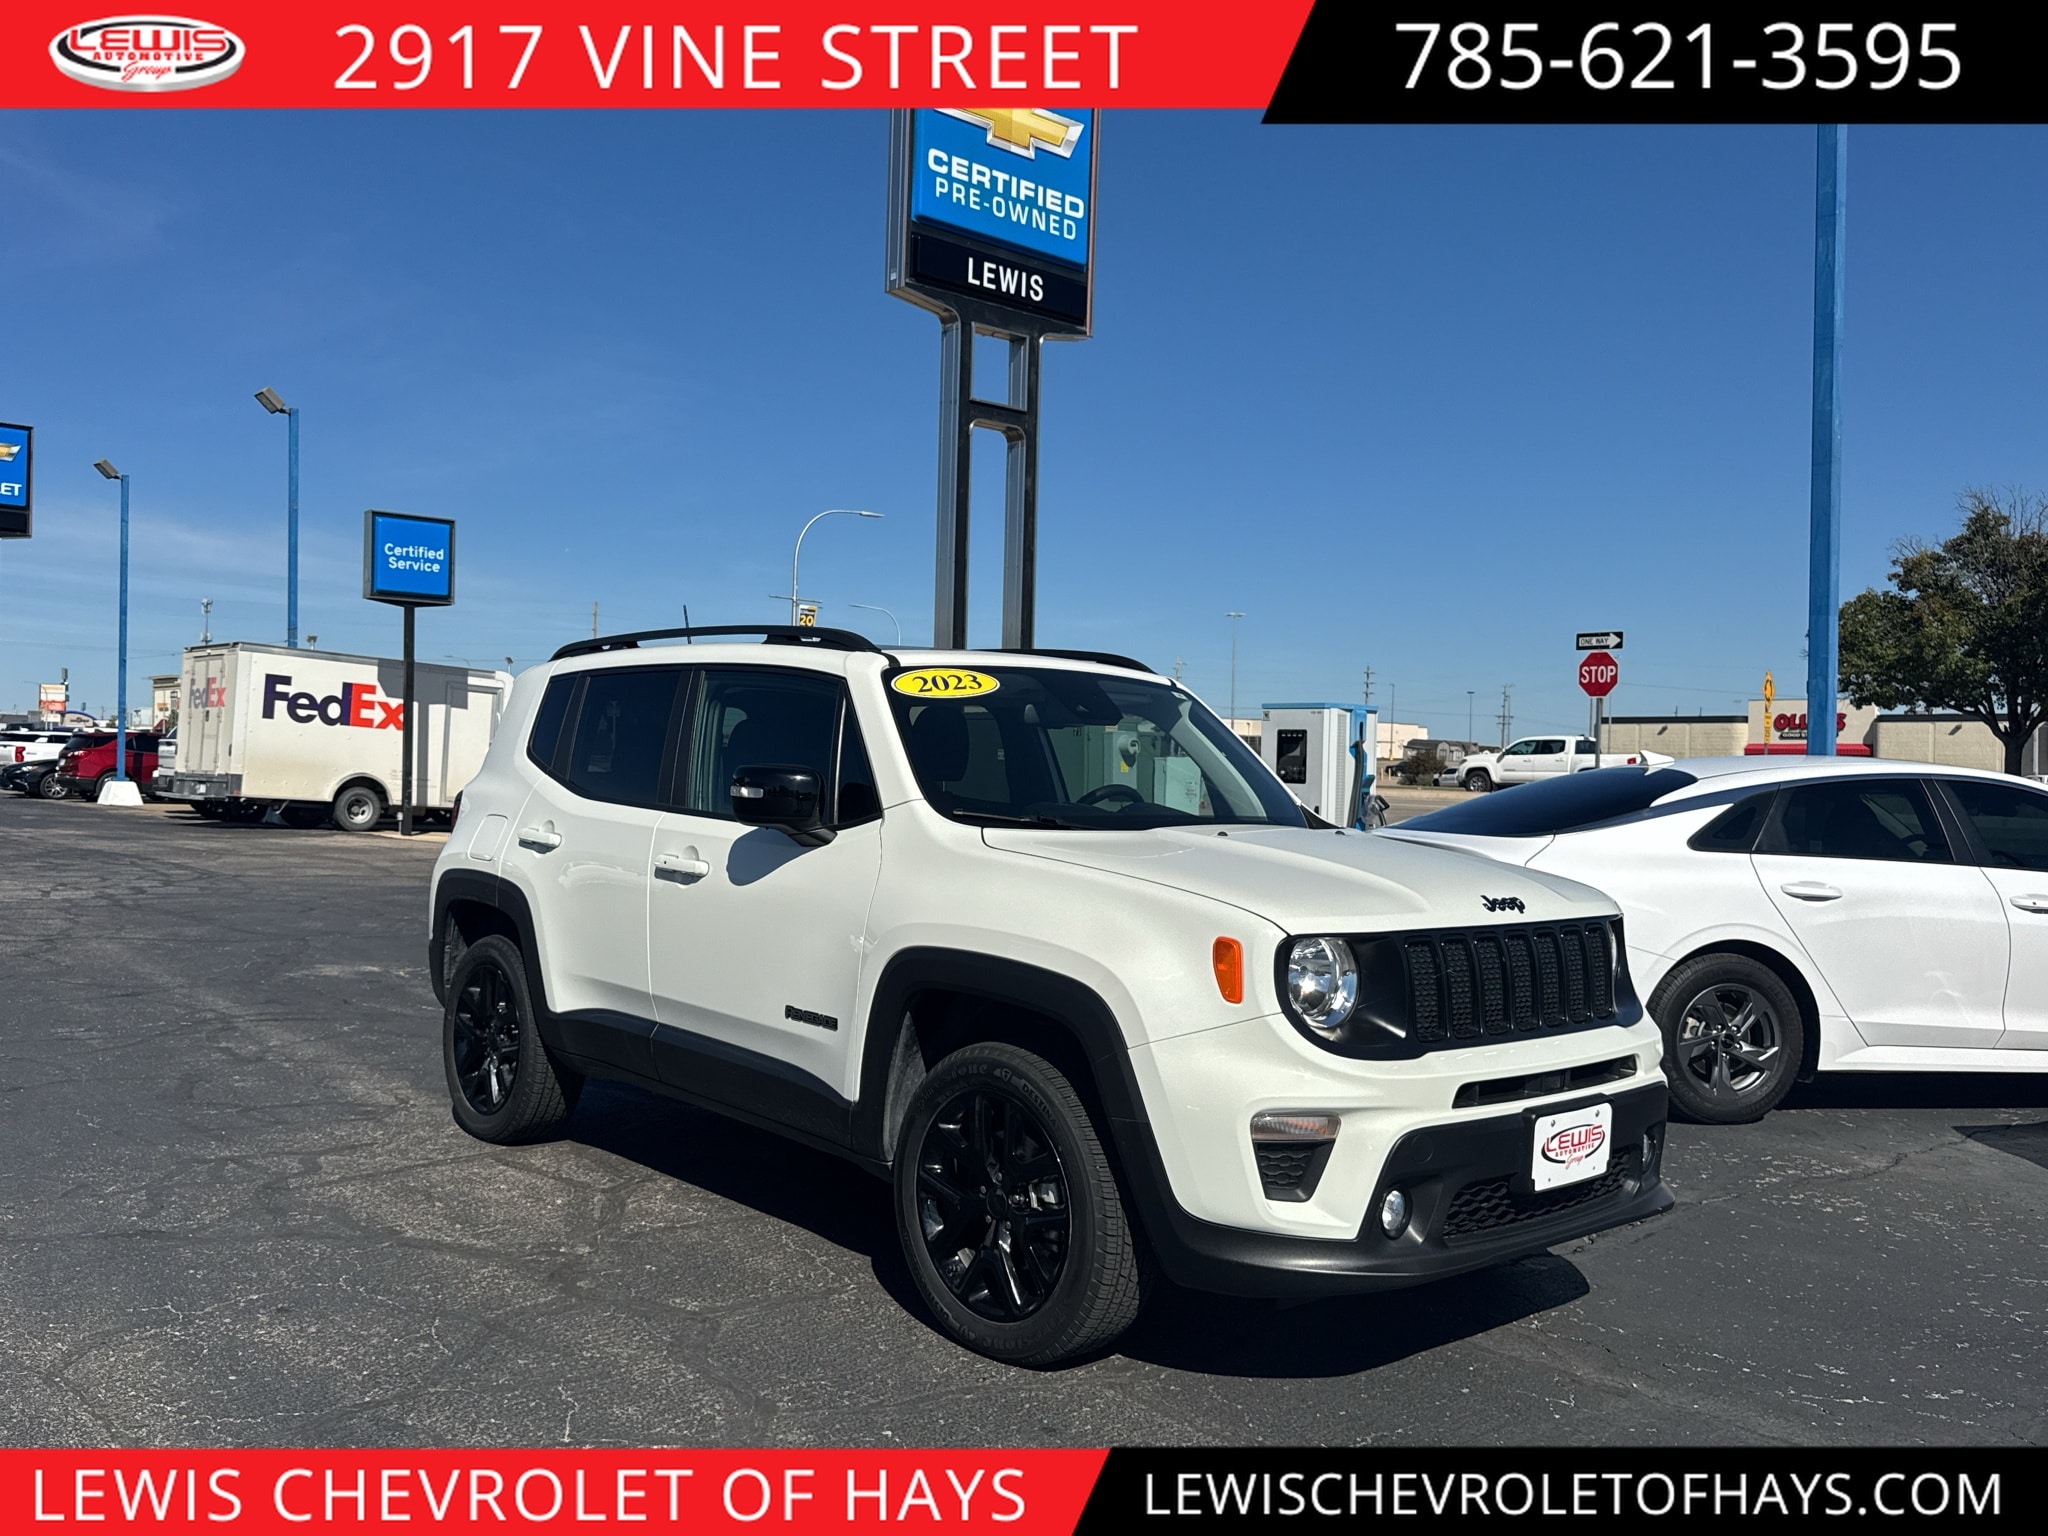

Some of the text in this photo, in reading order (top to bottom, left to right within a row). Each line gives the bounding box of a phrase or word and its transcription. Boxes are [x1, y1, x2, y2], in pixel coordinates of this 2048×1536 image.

[928, 148, 1085, 219] CERTIFIED
[935, 176, 1077, 241] PRE-OWNED
[967, 256, 1044, 302] LEWIS
[384, 543, 444, 560] Certified
[388, 556, 441, 573] Service
[1580, 636, 1609, 646] ONE WAY
[912, 674, 982, 692] 2023
[1580, 665, 1616, 684] STOP
[189, 676, 226, 709] FedEx
[262, 673, 404, 731] FedEx
[1480, 894, 1526, 914] Jeep
[784, 1004, 838, 1032] RENEGADE
[1546, 1124, 1603, 1153] LEWIS
[1555, 1142, 1595, 1158] AUTOMOTIVE
